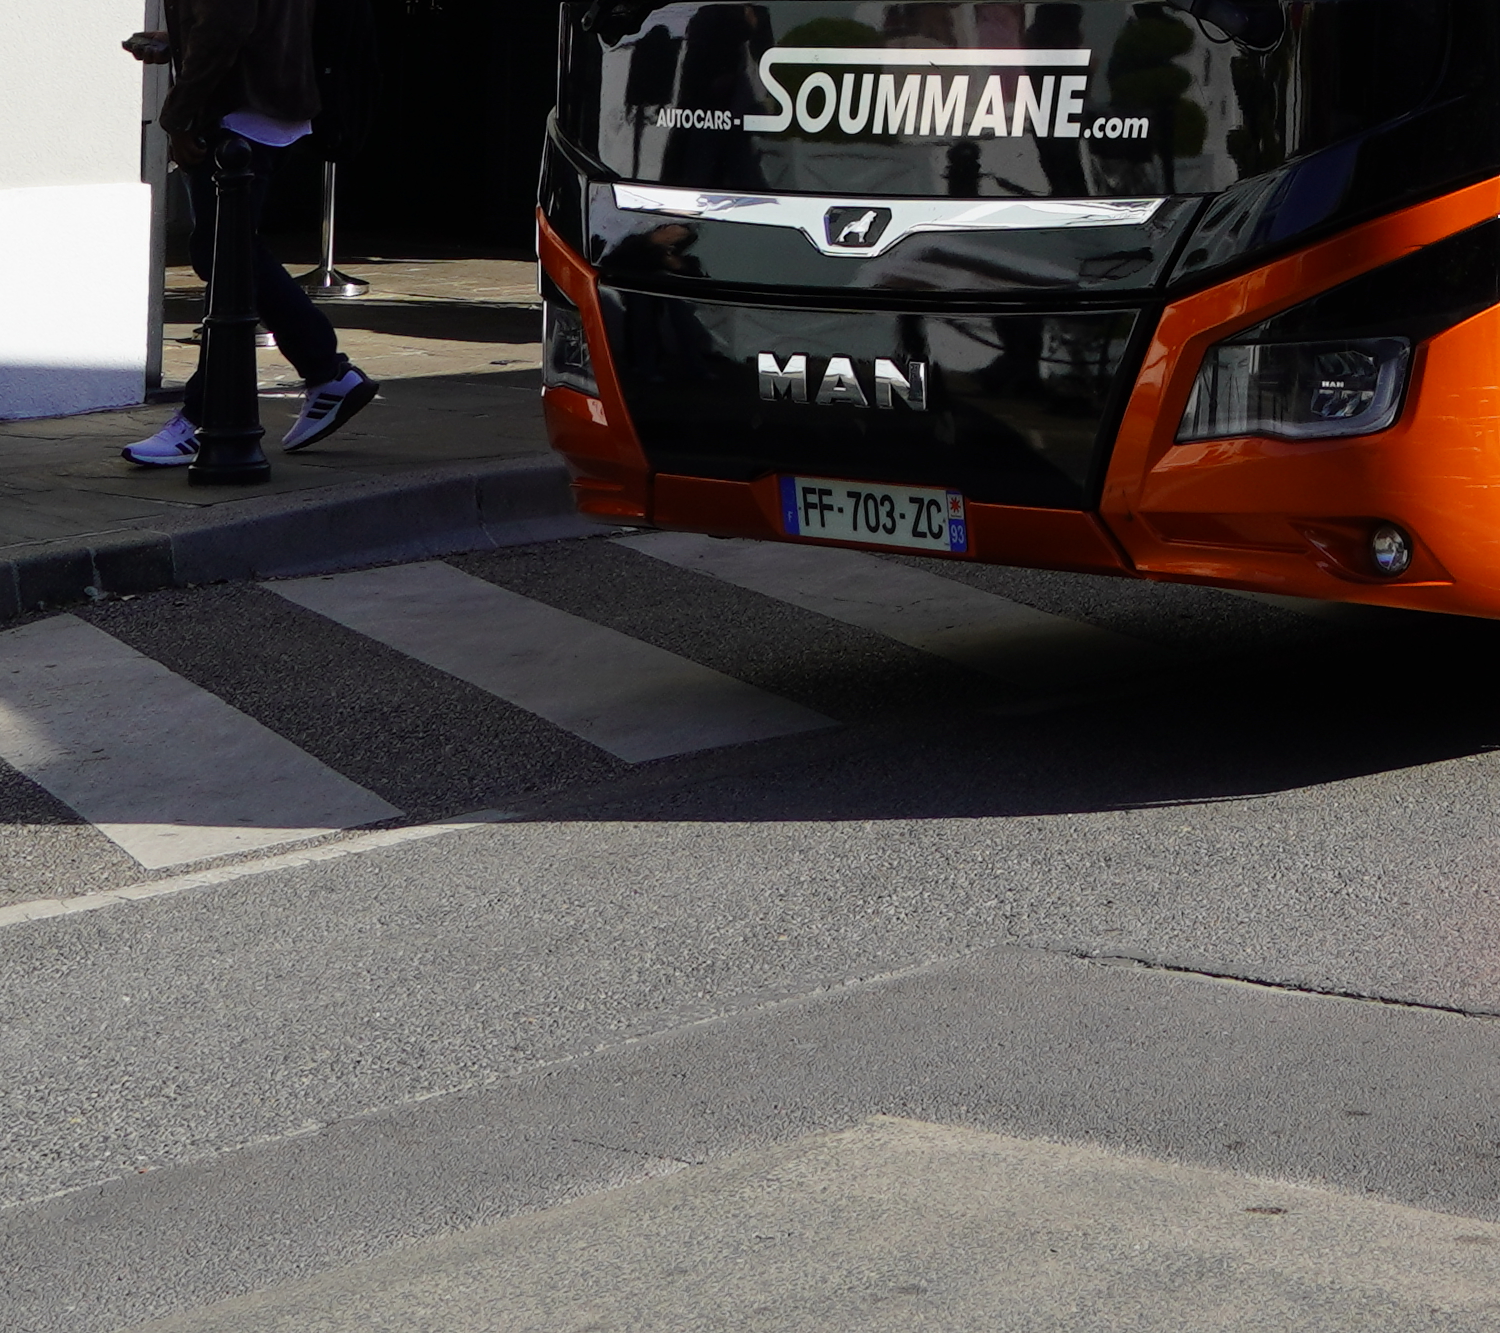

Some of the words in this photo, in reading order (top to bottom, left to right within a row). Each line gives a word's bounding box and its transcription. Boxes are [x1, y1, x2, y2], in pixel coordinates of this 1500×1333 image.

[756, 351, 929, 412] MAN
[801, 486, 944, 540] FF-703-ZC
[950, 524, 965, 544] 93
